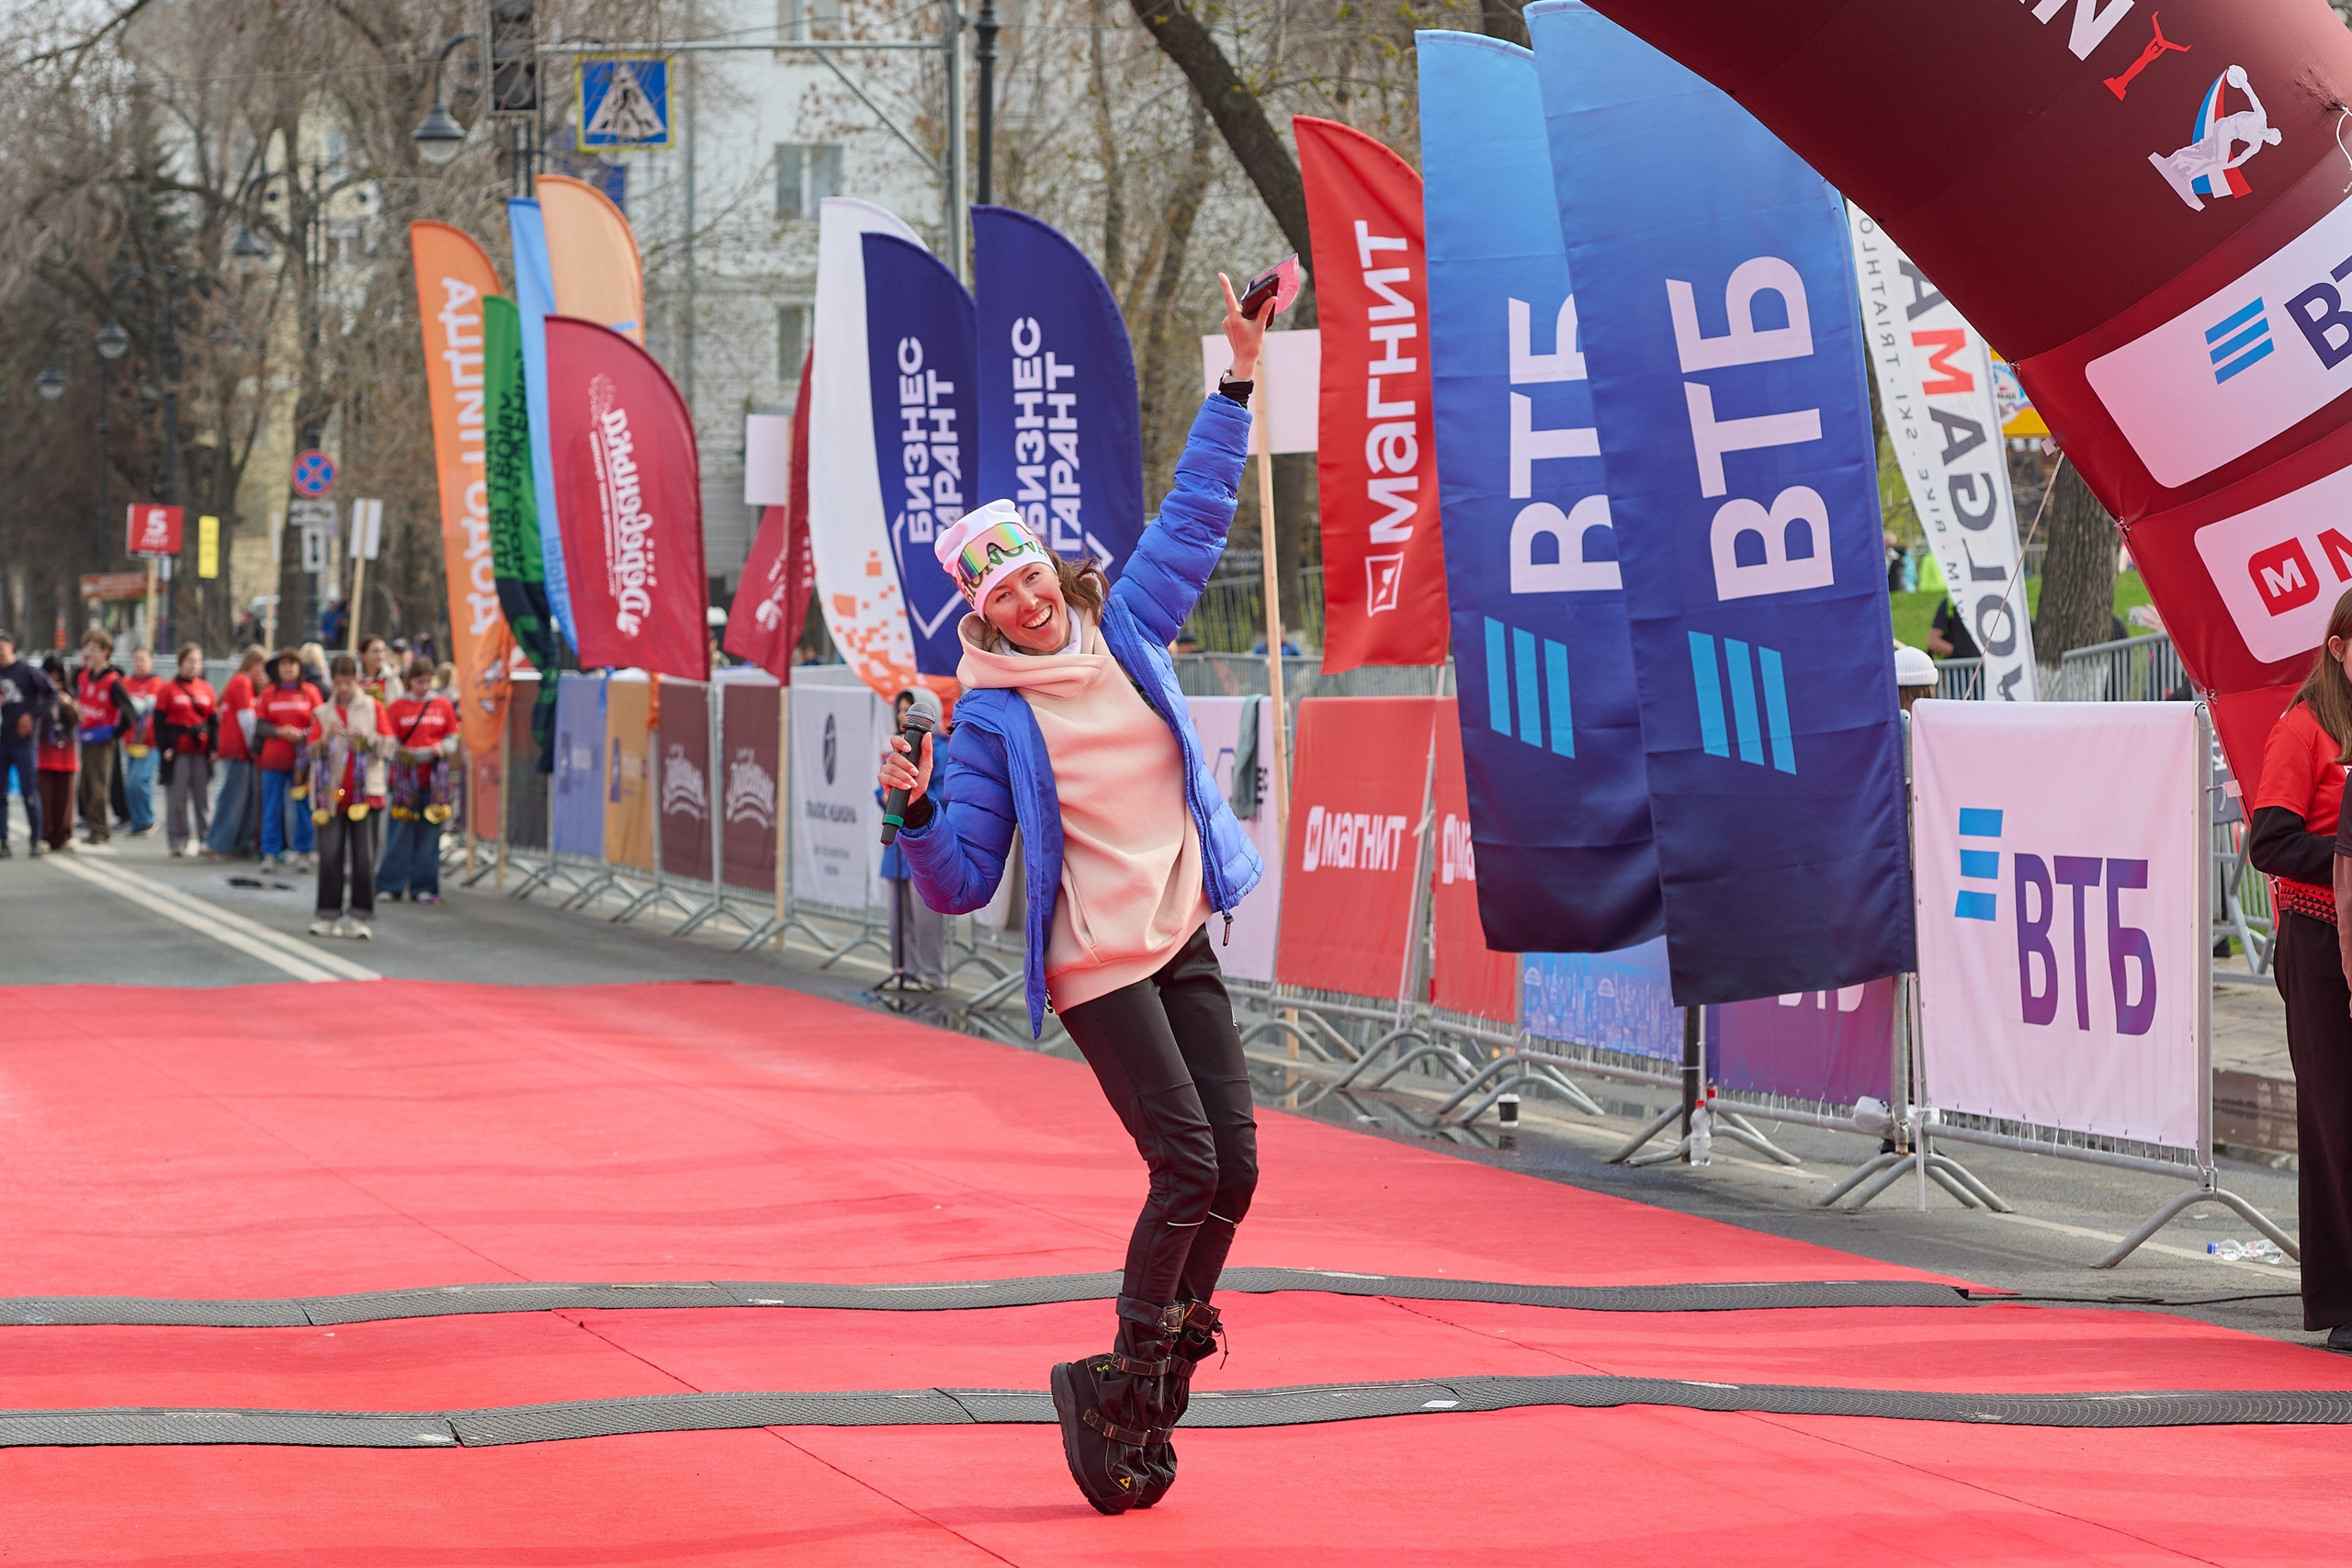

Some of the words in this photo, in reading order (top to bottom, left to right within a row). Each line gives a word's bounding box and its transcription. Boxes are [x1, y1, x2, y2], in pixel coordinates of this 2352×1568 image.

[145, 508, 168, 536] 5
[898, 336, 935, 544] БИЗНЕС
[1011, 316, 1048, 537] БИЗНЕС
[1045, 351, 1083, 551] ГАРАНТ
[1665, 256, 1836, 602] ВТБ
[2014, 852, 2158, 1036] ВТБ
